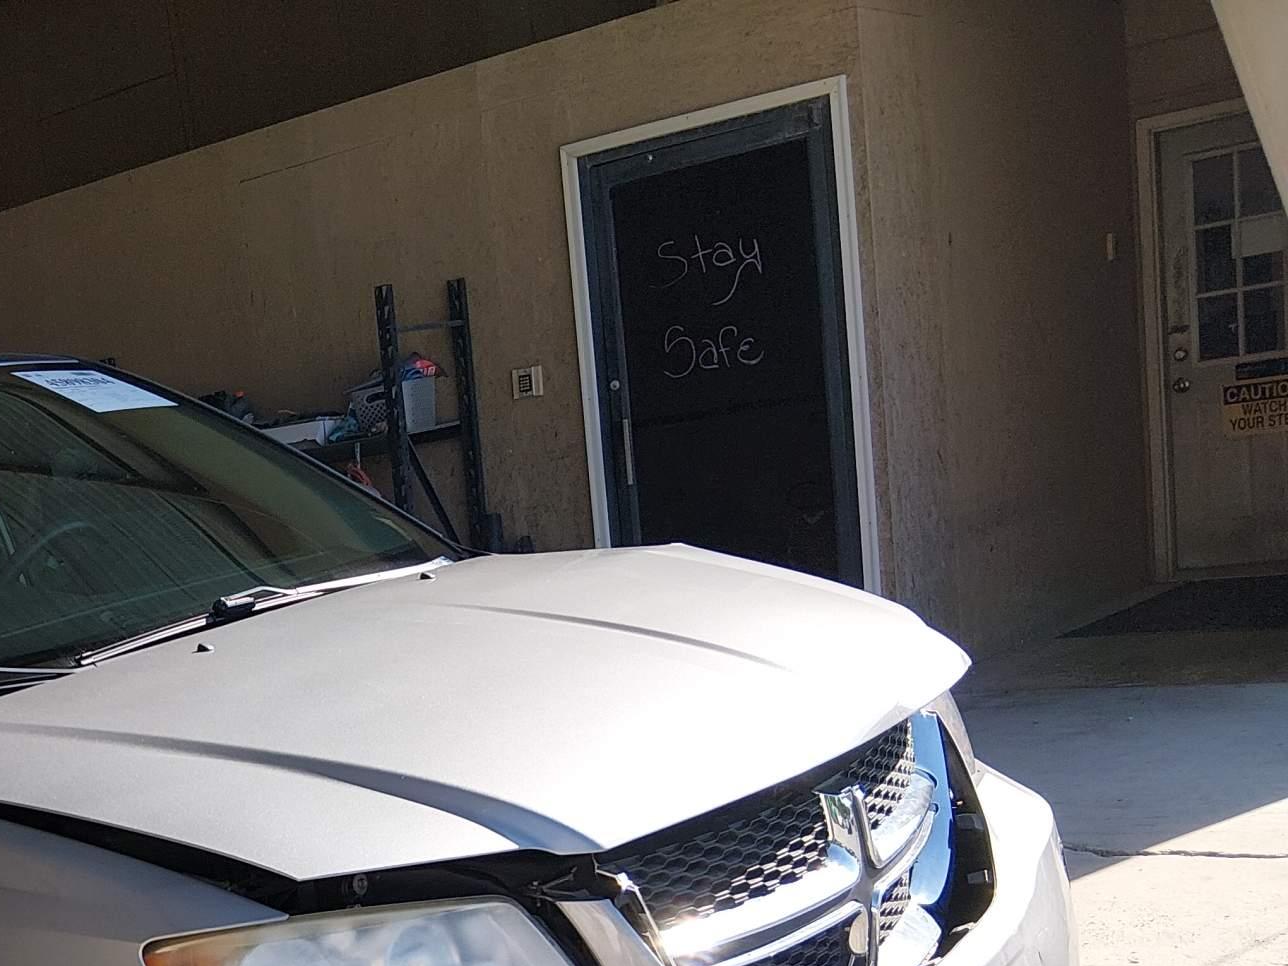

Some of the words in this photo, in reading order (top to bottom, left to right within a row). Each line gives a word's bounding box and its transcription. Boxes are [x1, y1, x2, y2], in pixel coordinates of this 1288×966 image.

[653, 233, 762, 306] Stay
[664, 325, 764, 378] Safe
[1226, 381, 1288, 402] CAUTIO
[1241, 400, 1287, 416] WATCH
[1229, 415, 1265, 431] YOUR
[1268, 413, 1288, 427] STE
